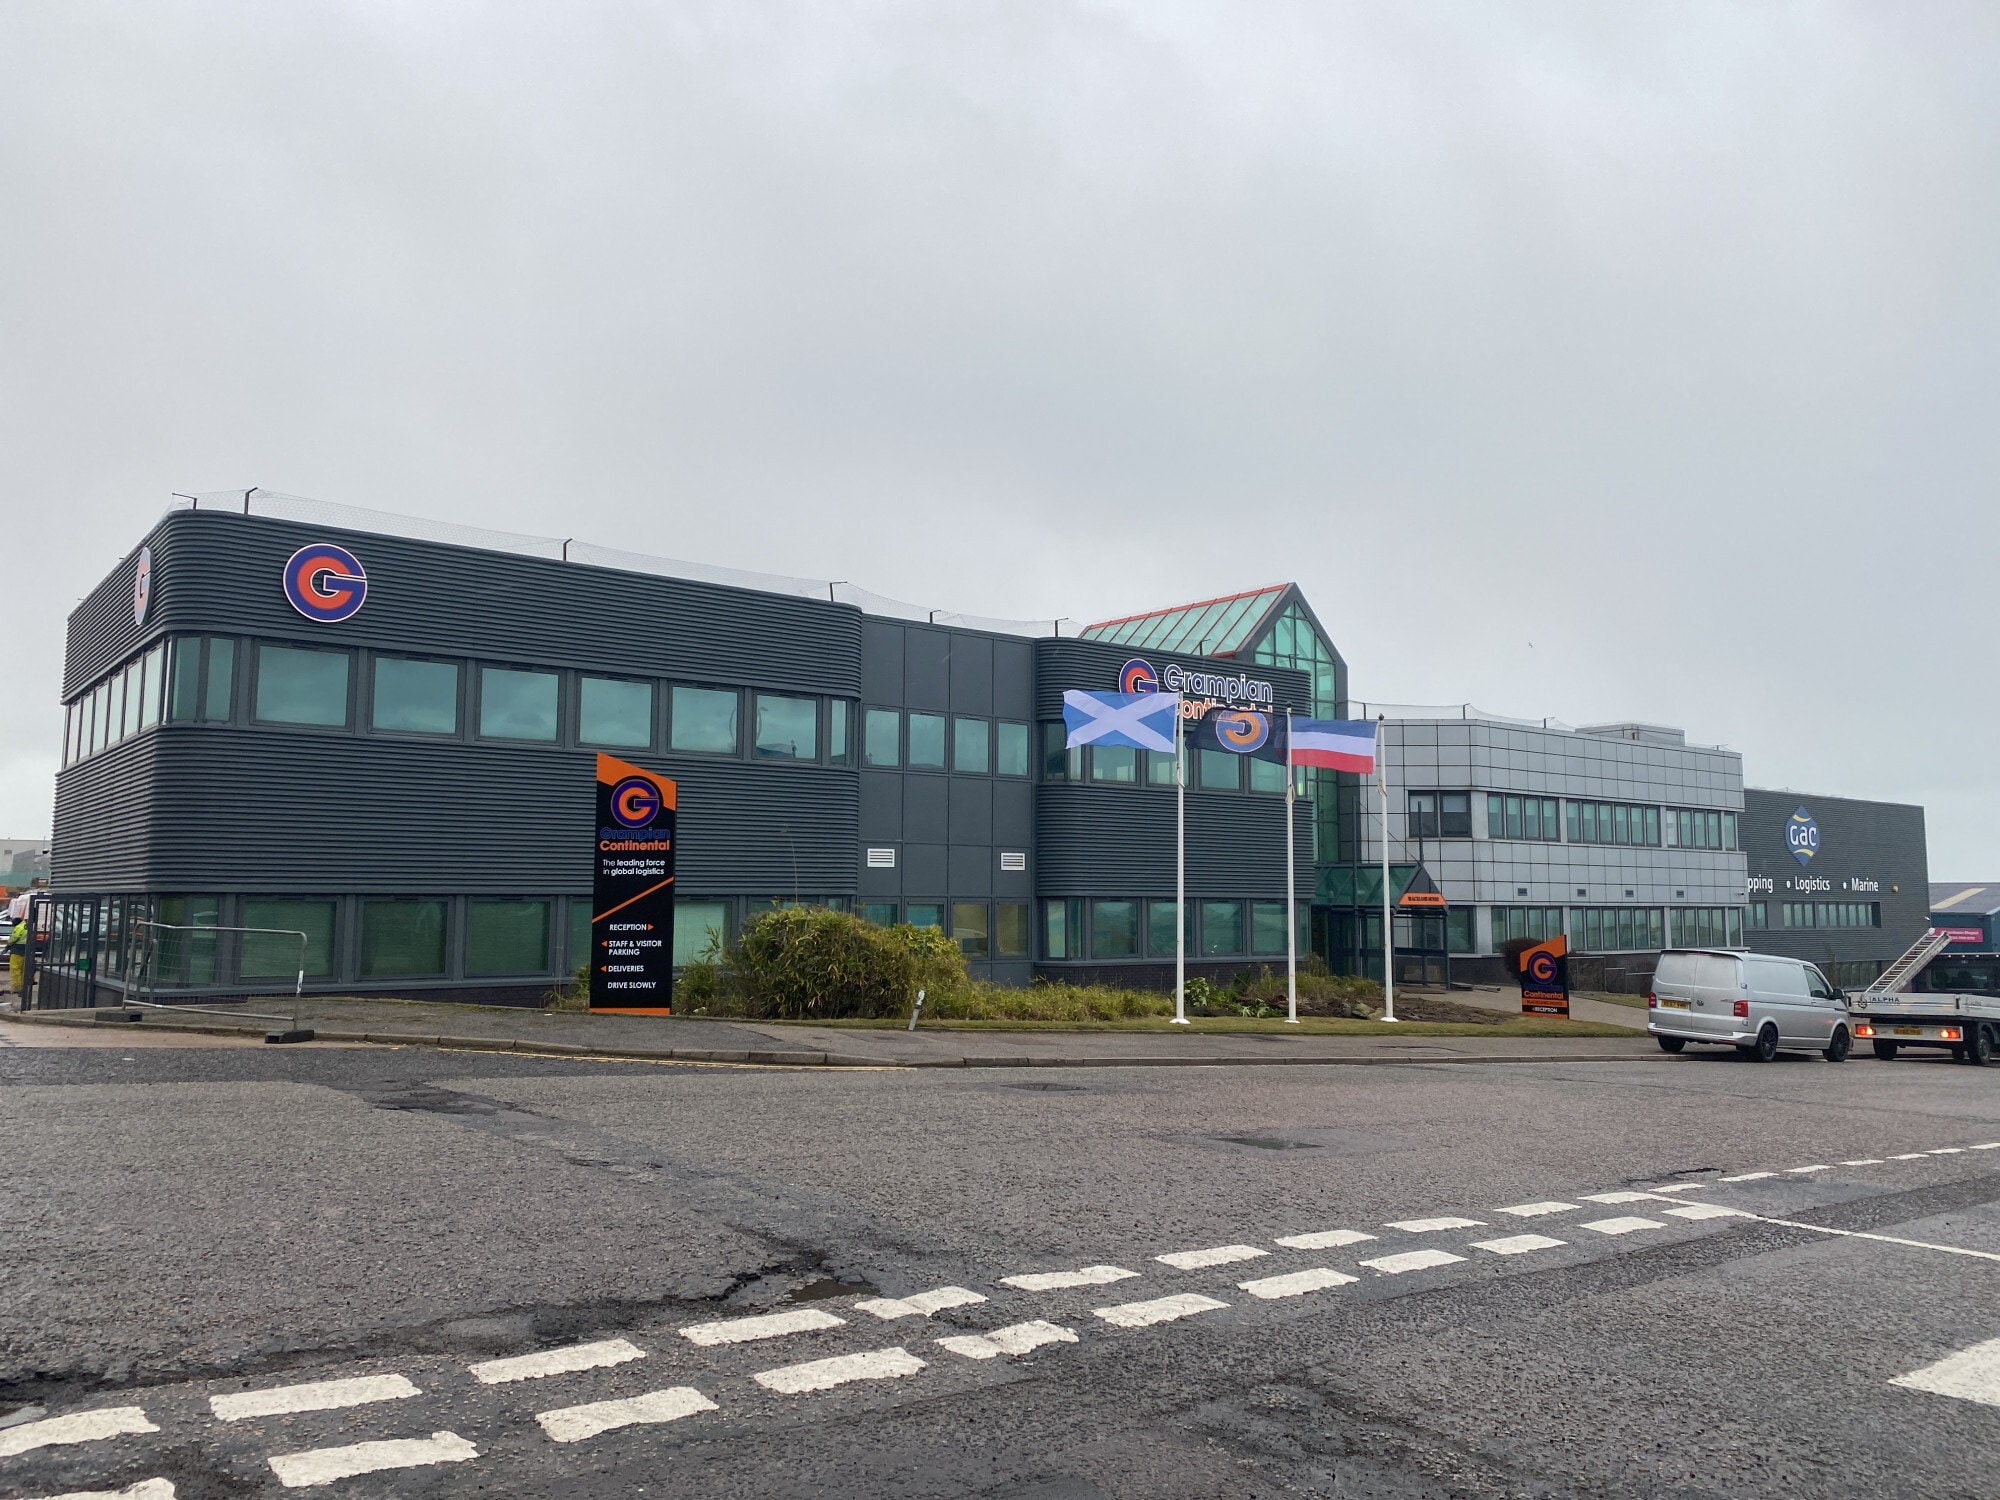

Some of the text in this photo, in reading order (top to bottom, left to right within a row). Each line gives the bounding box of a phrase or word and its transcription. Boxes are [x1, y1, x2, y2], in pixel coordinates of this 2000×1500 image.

[283, 543, 367, 623] G
[1164, 664, 1273, 703] Grampian
[611, 779, 660, 828] G
[600, 827, 671, 841] Grampian
[600, 840, 670, 851] Continental
[603, 859, 666, 868] The leading force
[610, 868, 634, 877] global
[635, 868, 665, 877] logistics
[1794, 876, 1831, 894] Logistics
[1851, 878, 1879, 892] Marine
[609, 923, 647, 931] RECEPTION
[608, 940, 629, 948] STAFF
[629, 940, 635, 948] &
[608, 948, 641, 956] PARKING
[608, 965, 645, 973] DELIVERIES
[607, 981, 657, 989] DRIVE SLOWLY
[1523, 990, 1564, 1000] Continental
